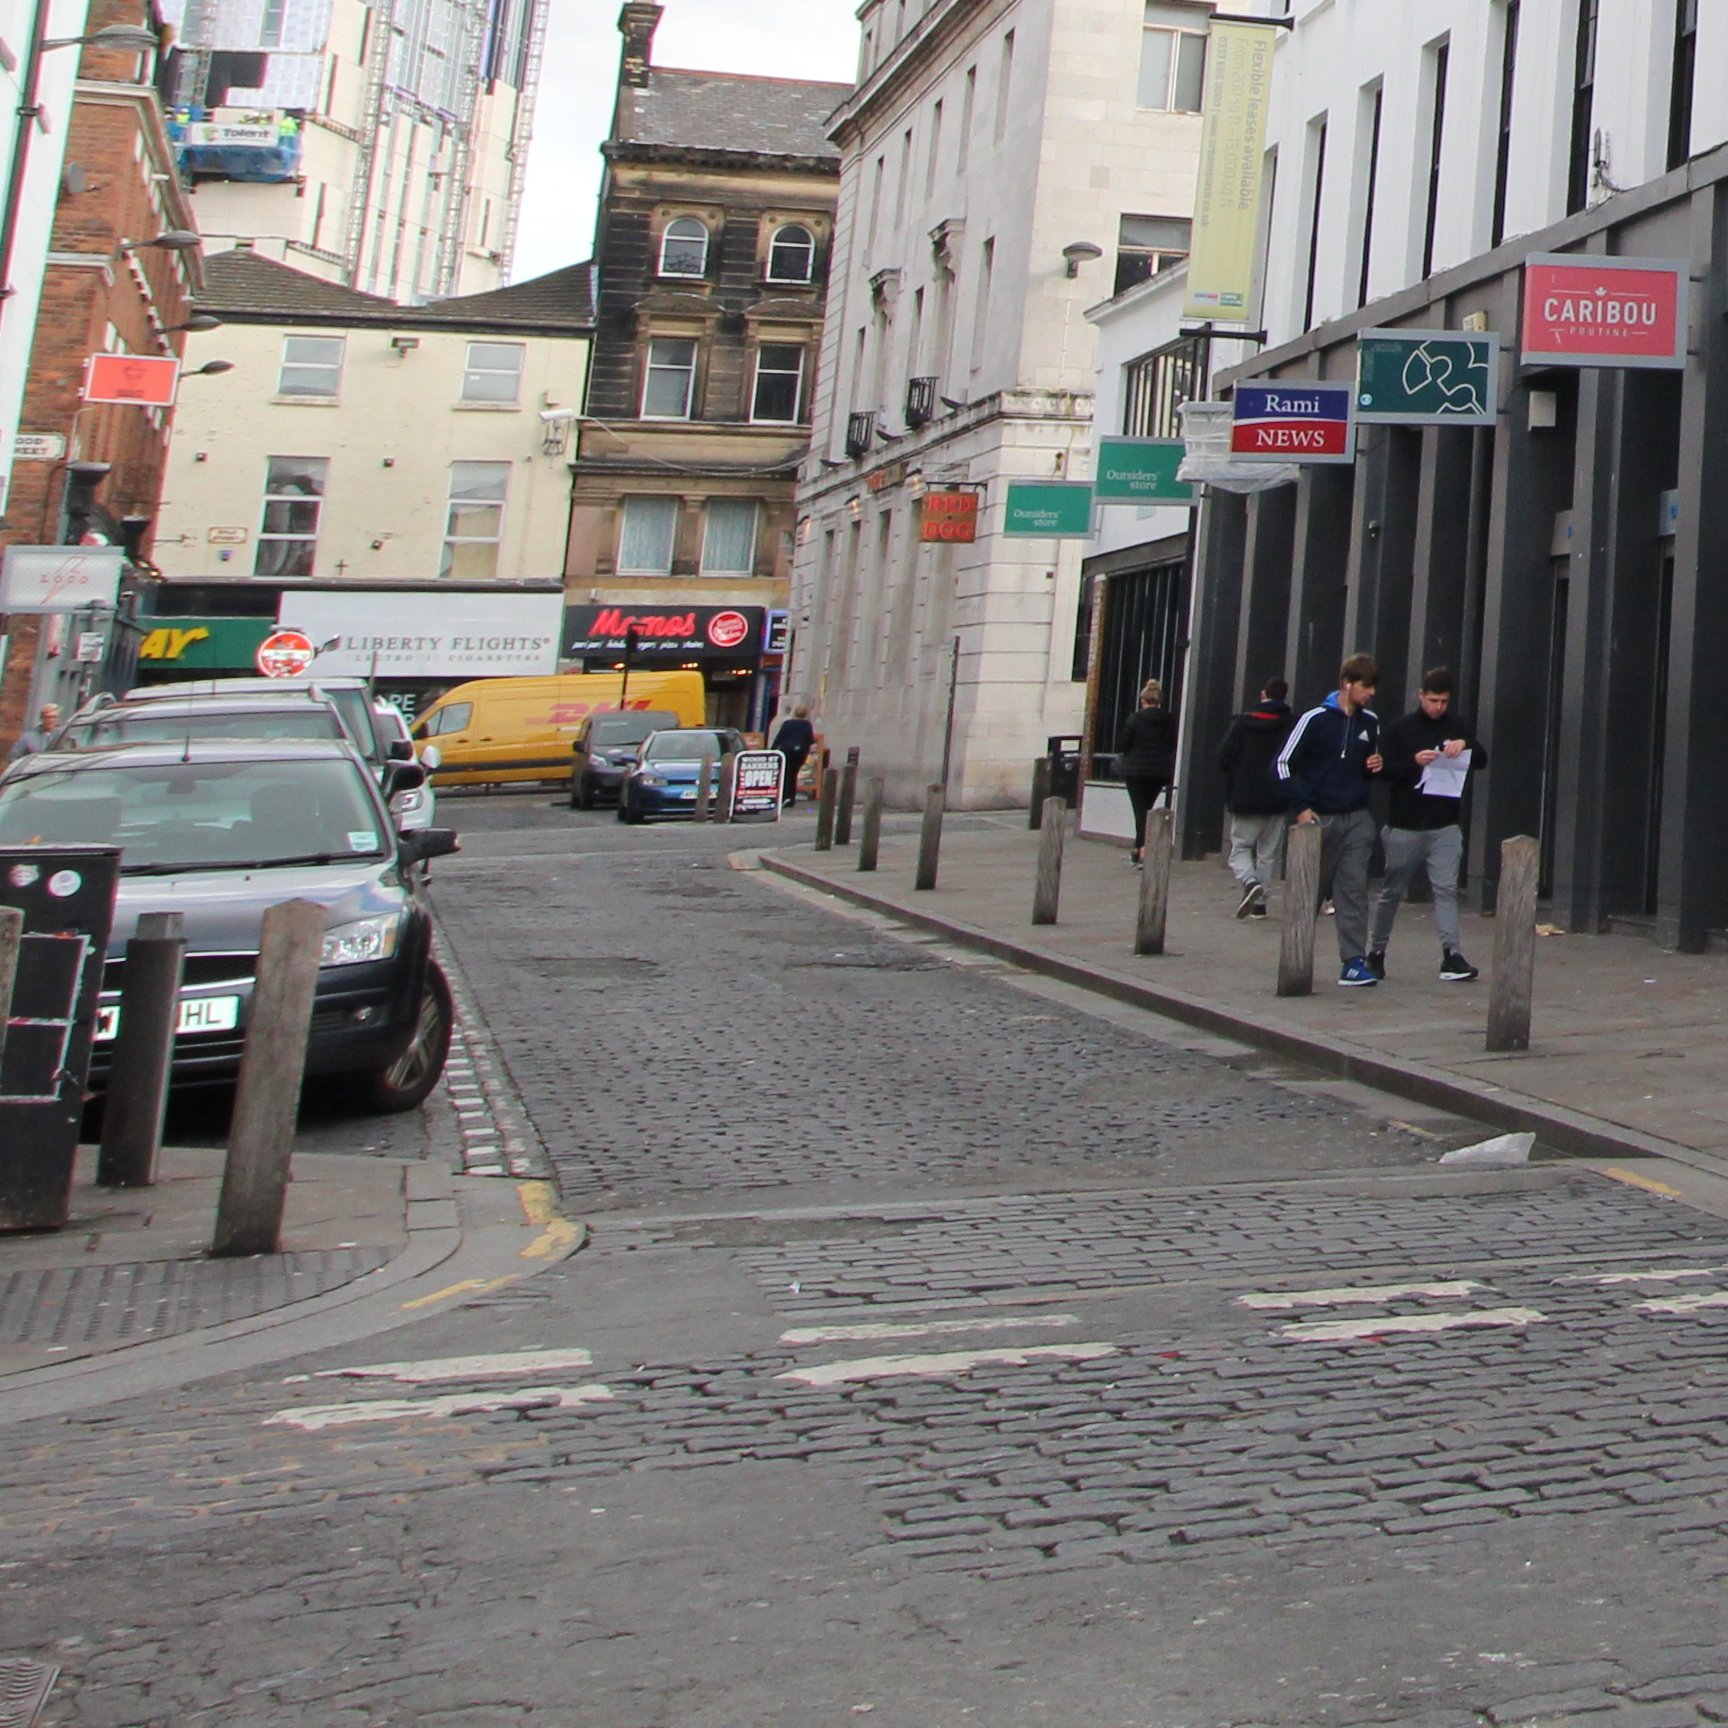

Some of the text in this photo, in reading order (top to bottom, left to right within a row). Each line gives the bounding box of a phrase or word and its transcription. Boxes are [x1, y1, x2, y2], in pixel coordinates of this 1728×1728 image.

[1238, 39, 1268, 210] Flexible leases available
[1543, 297, 1657, 325] CARIBOU
[1570, 326, 1629, 337] POUTINE
[1265, 394, 1320, 414] Rami
[1256, 429, 1325, 448] NEWS
[1129, 480, 1157, 490] store
[928, 495, 972, 513] RED
[922, 522, 974, 540] DOG
[1033, 518, 1058, 527] store
[347, 636, 443, 651] LIBERTY
[745, 770, 773, 787] OPEN
